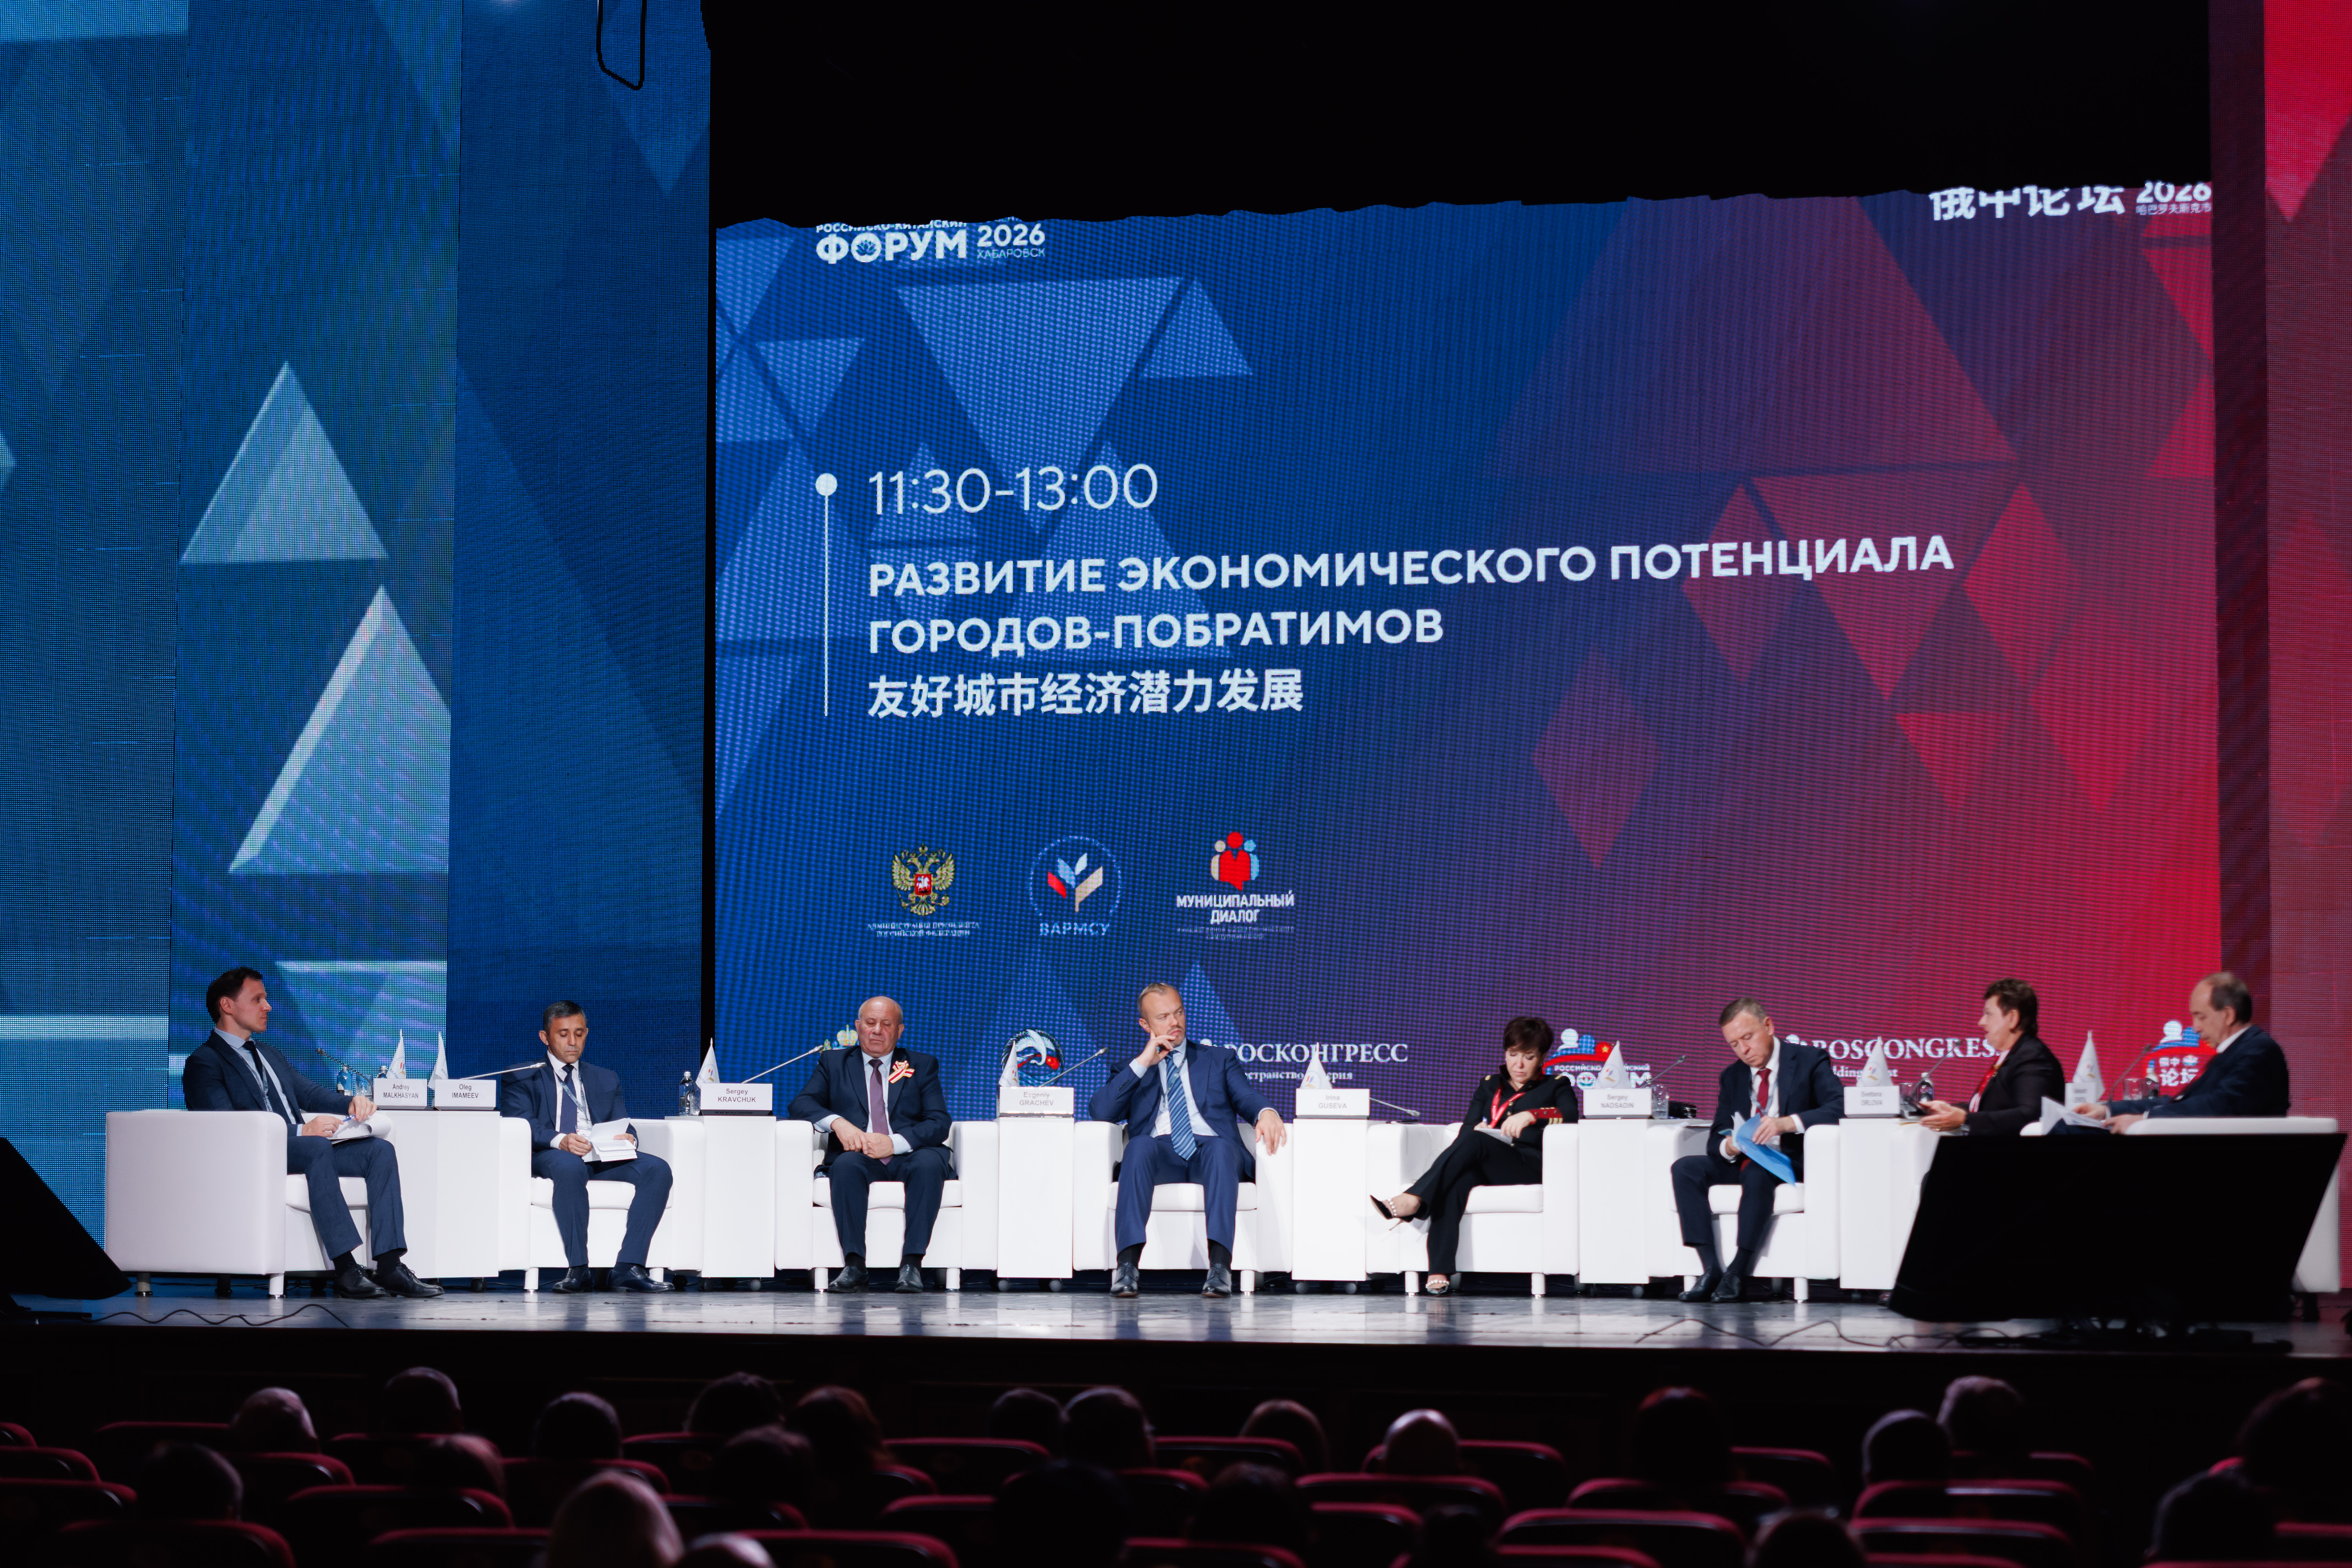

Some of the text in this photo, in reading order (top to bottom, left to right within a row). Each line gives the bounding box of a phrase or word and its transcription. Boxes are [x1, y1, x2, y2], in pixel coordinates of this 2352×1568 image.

[2136, 181, 2211, 203] 2026
[816, 223, 1045, 264] ФОРУМ 2026
[977, 248, 1045, 259] ХАБАРОВСК
[870, 535, 1954, 597] РАЗВИТИЕ ЭКОНОМИЧЕСКОГО ПОТЕНЦИАЛА
[870, 609, 1443, 659] ГОРОДОВ-ПОБРАТИМОВ
[868, 668, 1303, 718] 友好城市经济潜力发展
[1176, 890, 1294, 908] МУНИЦИПАЛЬНЫЙ
[1210, 909, 1260, 925] ДИАЛОГ
[1040, 922, 1110, 936] ВАРМСУ
[1224, 1043, 1408, 1062] ОСКОНГРЕСС
[1811, 1038, 2000, 1060] OSCONGRES
[1245, 1071, 1305, 1082] странство
